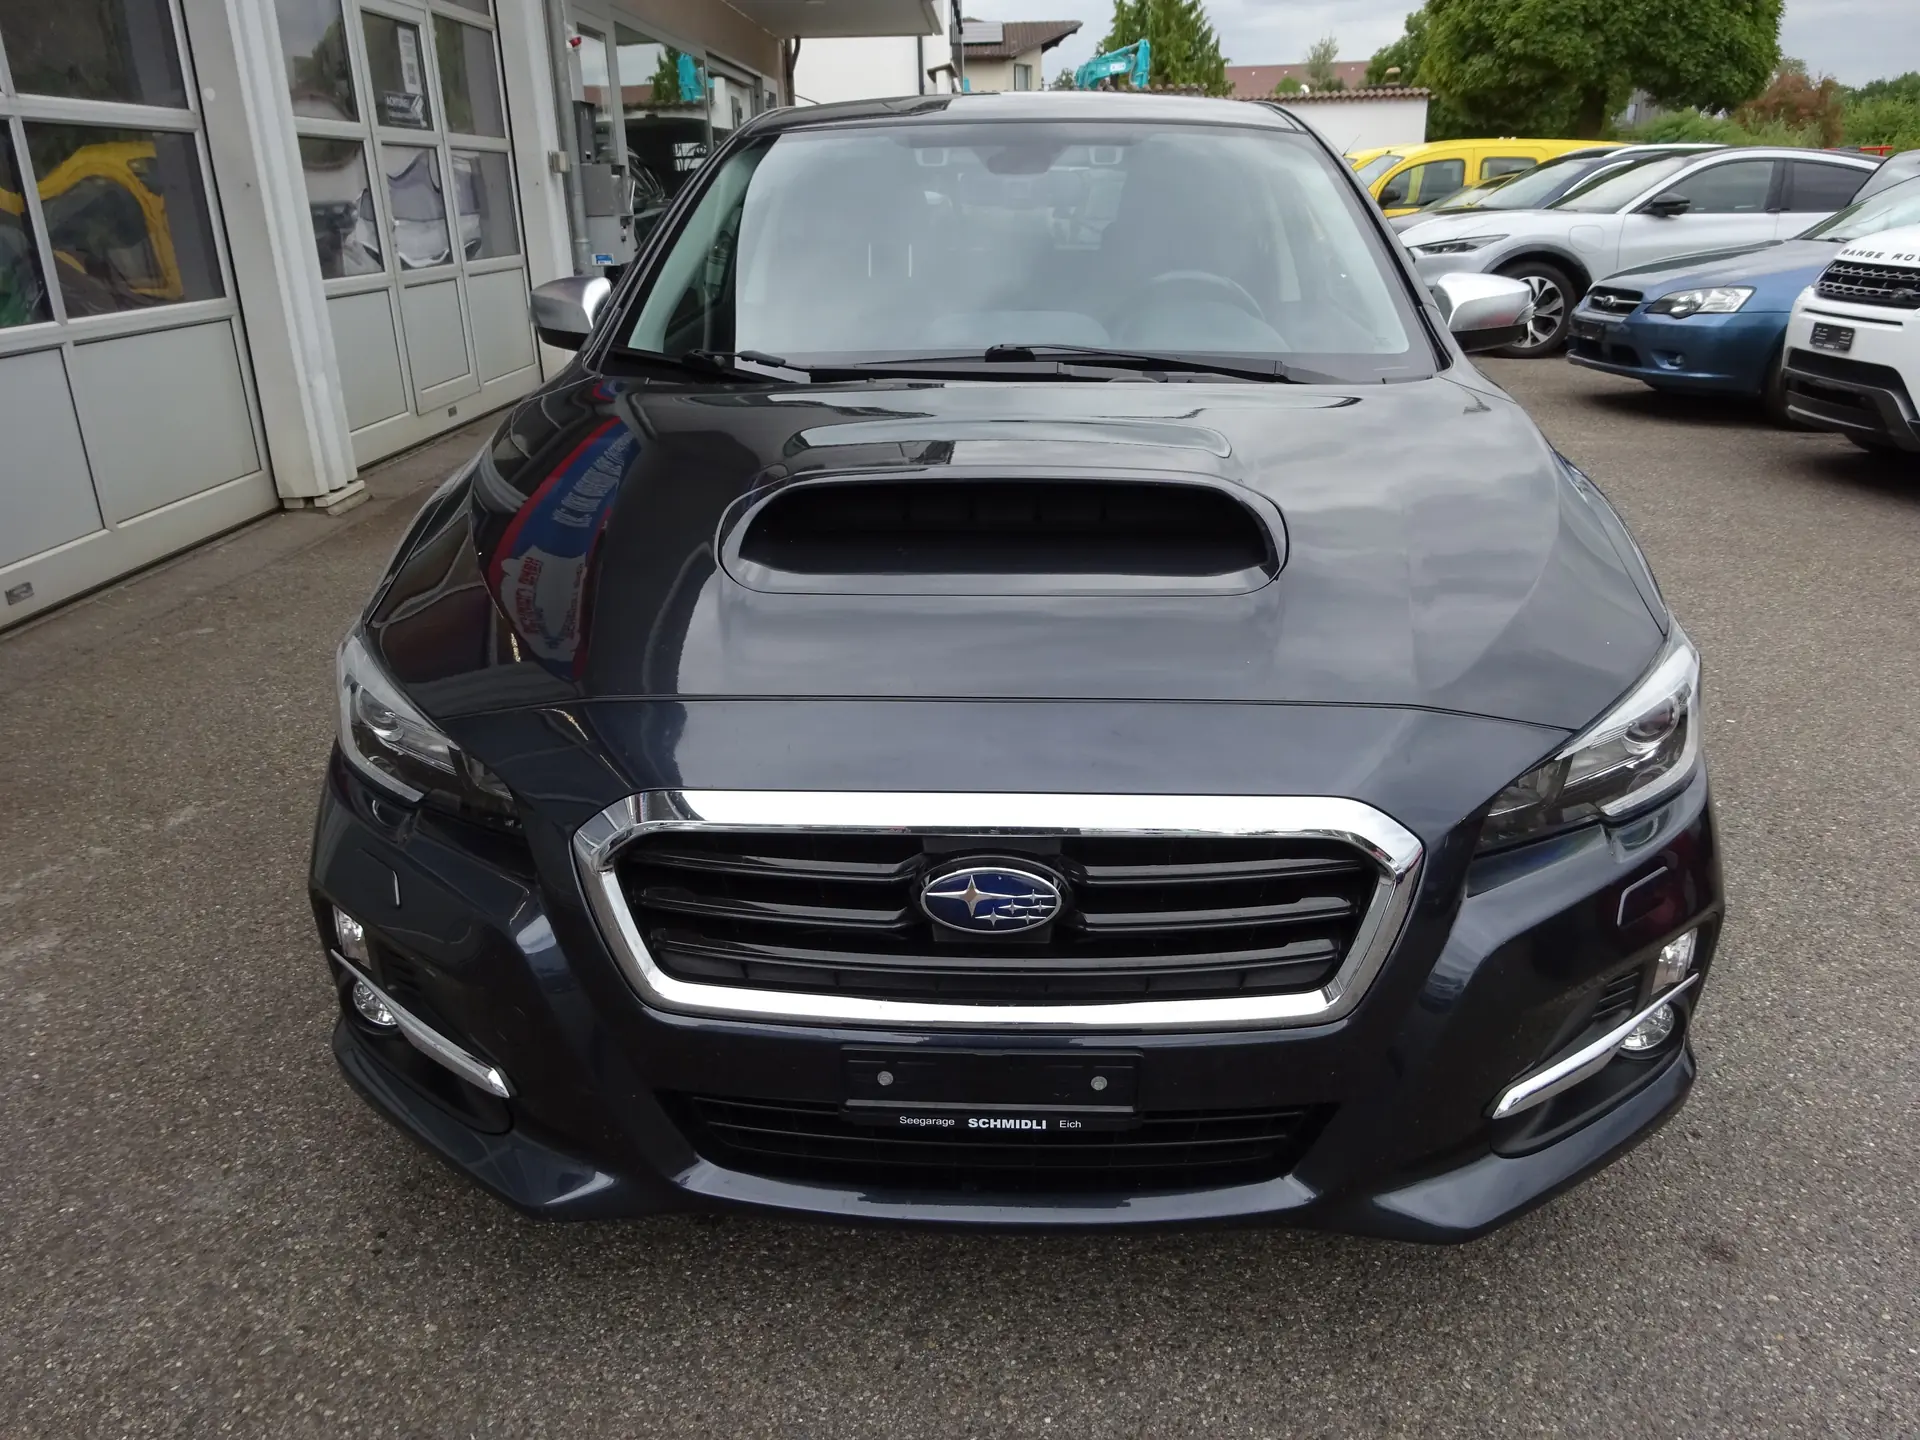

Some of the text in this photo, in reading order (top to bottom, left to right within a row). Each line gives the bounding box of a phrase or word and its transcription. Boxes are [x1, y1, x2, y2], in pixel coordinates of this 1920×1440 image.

[1841, 248, 1885, 259] RANGE
[899, 1116, 1082, 1130] Seegarage SCHMIDLI Eich
